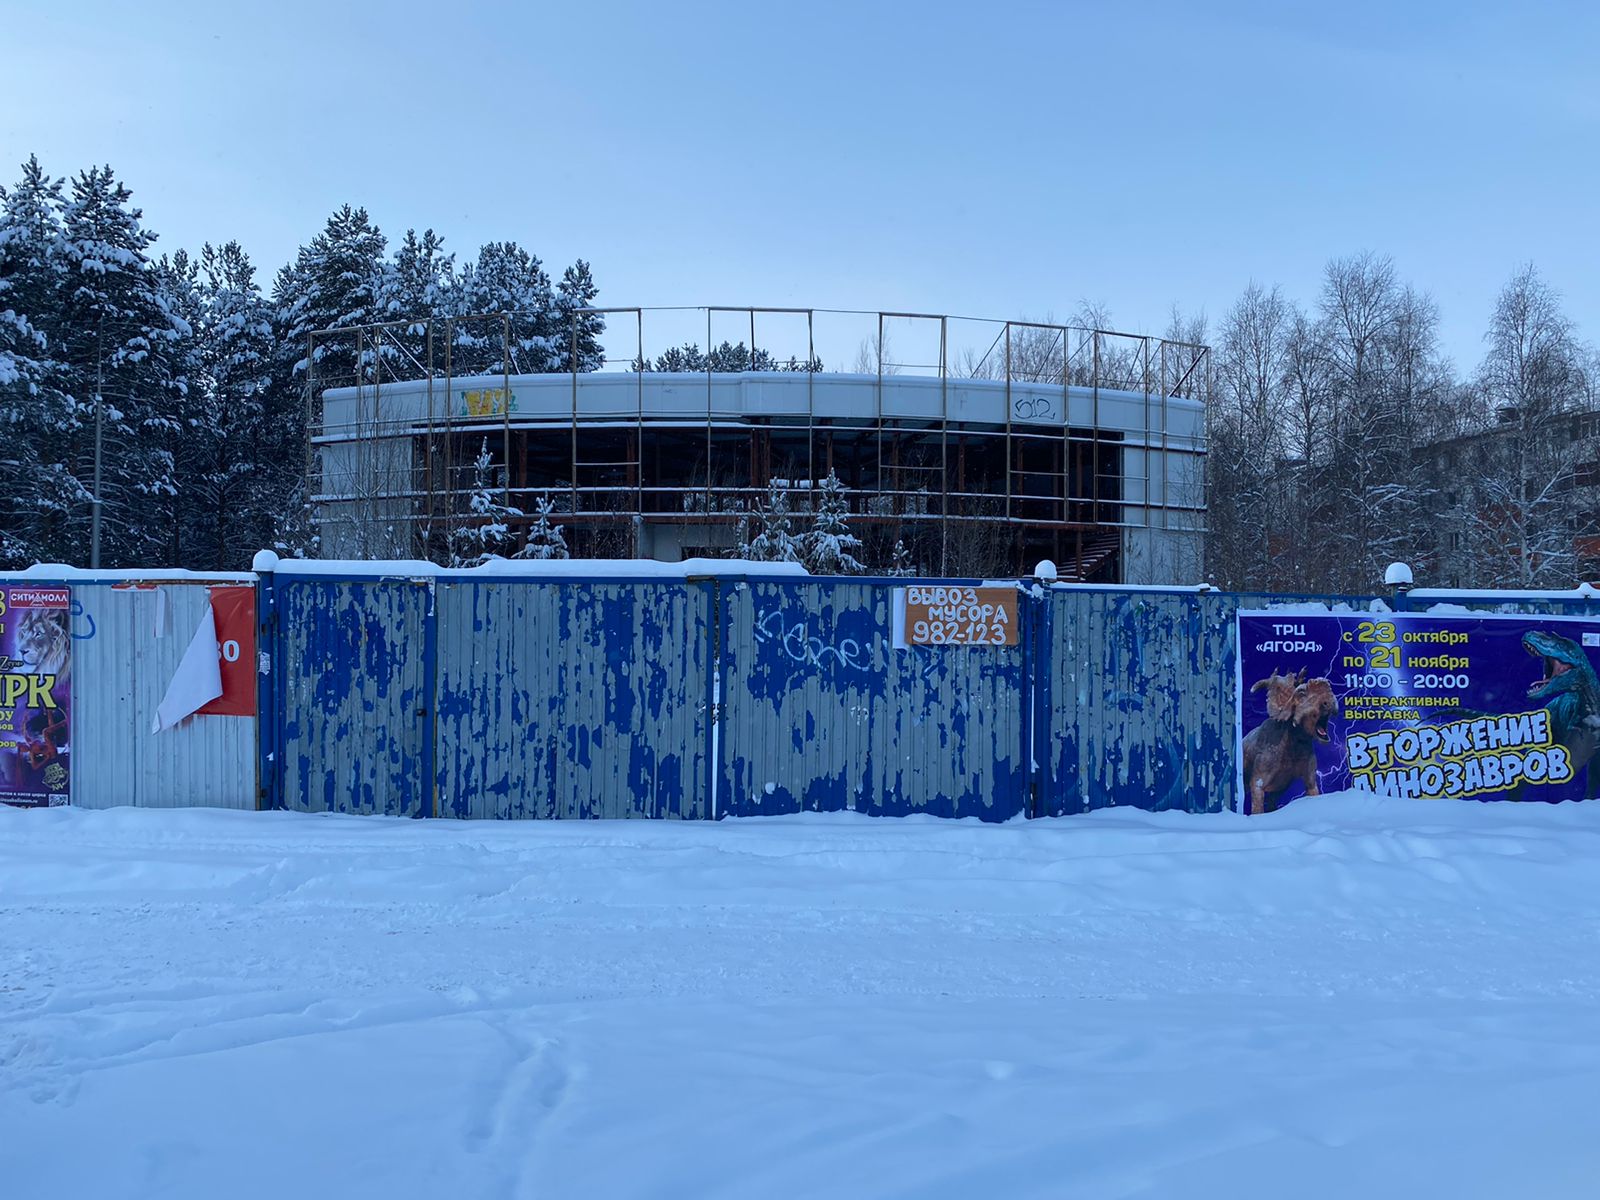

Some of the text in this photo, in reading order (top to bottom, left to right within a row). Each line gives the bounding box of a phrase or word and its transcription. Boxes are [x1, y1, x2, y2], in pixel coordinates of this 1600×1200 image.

[907, 587, 978, 606] ВЫВОЗ
[928, 604, 1009, 624] МУСОРА
[912, 620, 1007, 645] 982-123
[1272, 624, 1306, 636] ТРЦ
[1343, 622, 1469, 646] с 23 октября
[1255, 641, 1323, 653] «АГОРА»
[1343, 646, 1469, 671] по 21 ноября
[1343, 673, 1392, 689] 11:00
[1413, 673, 1470, 689] 20:00
[1344, 697, 1460, 707] ИНТЕРАКТИВНАЯ
[1344, 710, 1421, 720] ВЫСТАВКА
[1347, 711, 1549, 770] ВТОРЖЕНИЕ
